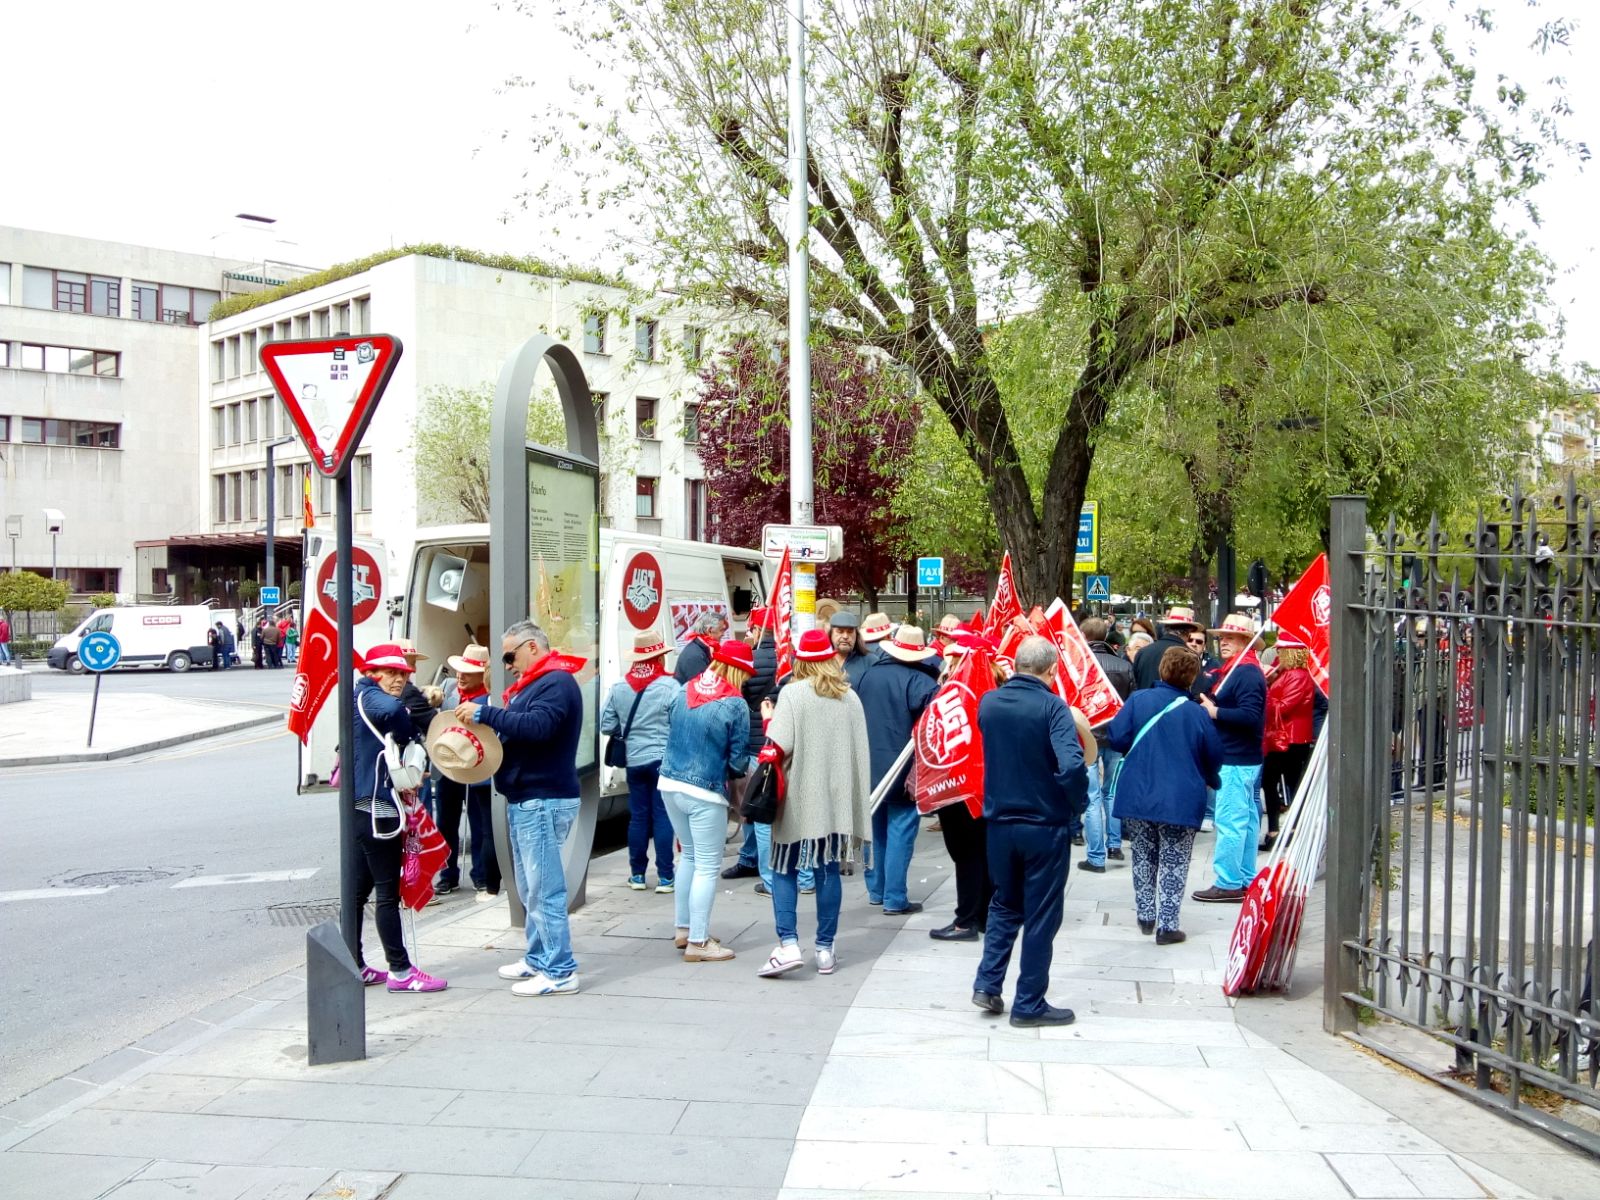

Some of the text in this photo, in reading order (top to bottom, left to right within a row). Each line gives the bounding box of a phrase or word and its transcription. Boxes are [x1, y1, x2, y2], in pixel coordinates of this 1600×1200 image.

[1077, 538, 1089, 547] AXI
[920, 567, 942, 576] TAXI
[937, 687, 972, 751] UGT
